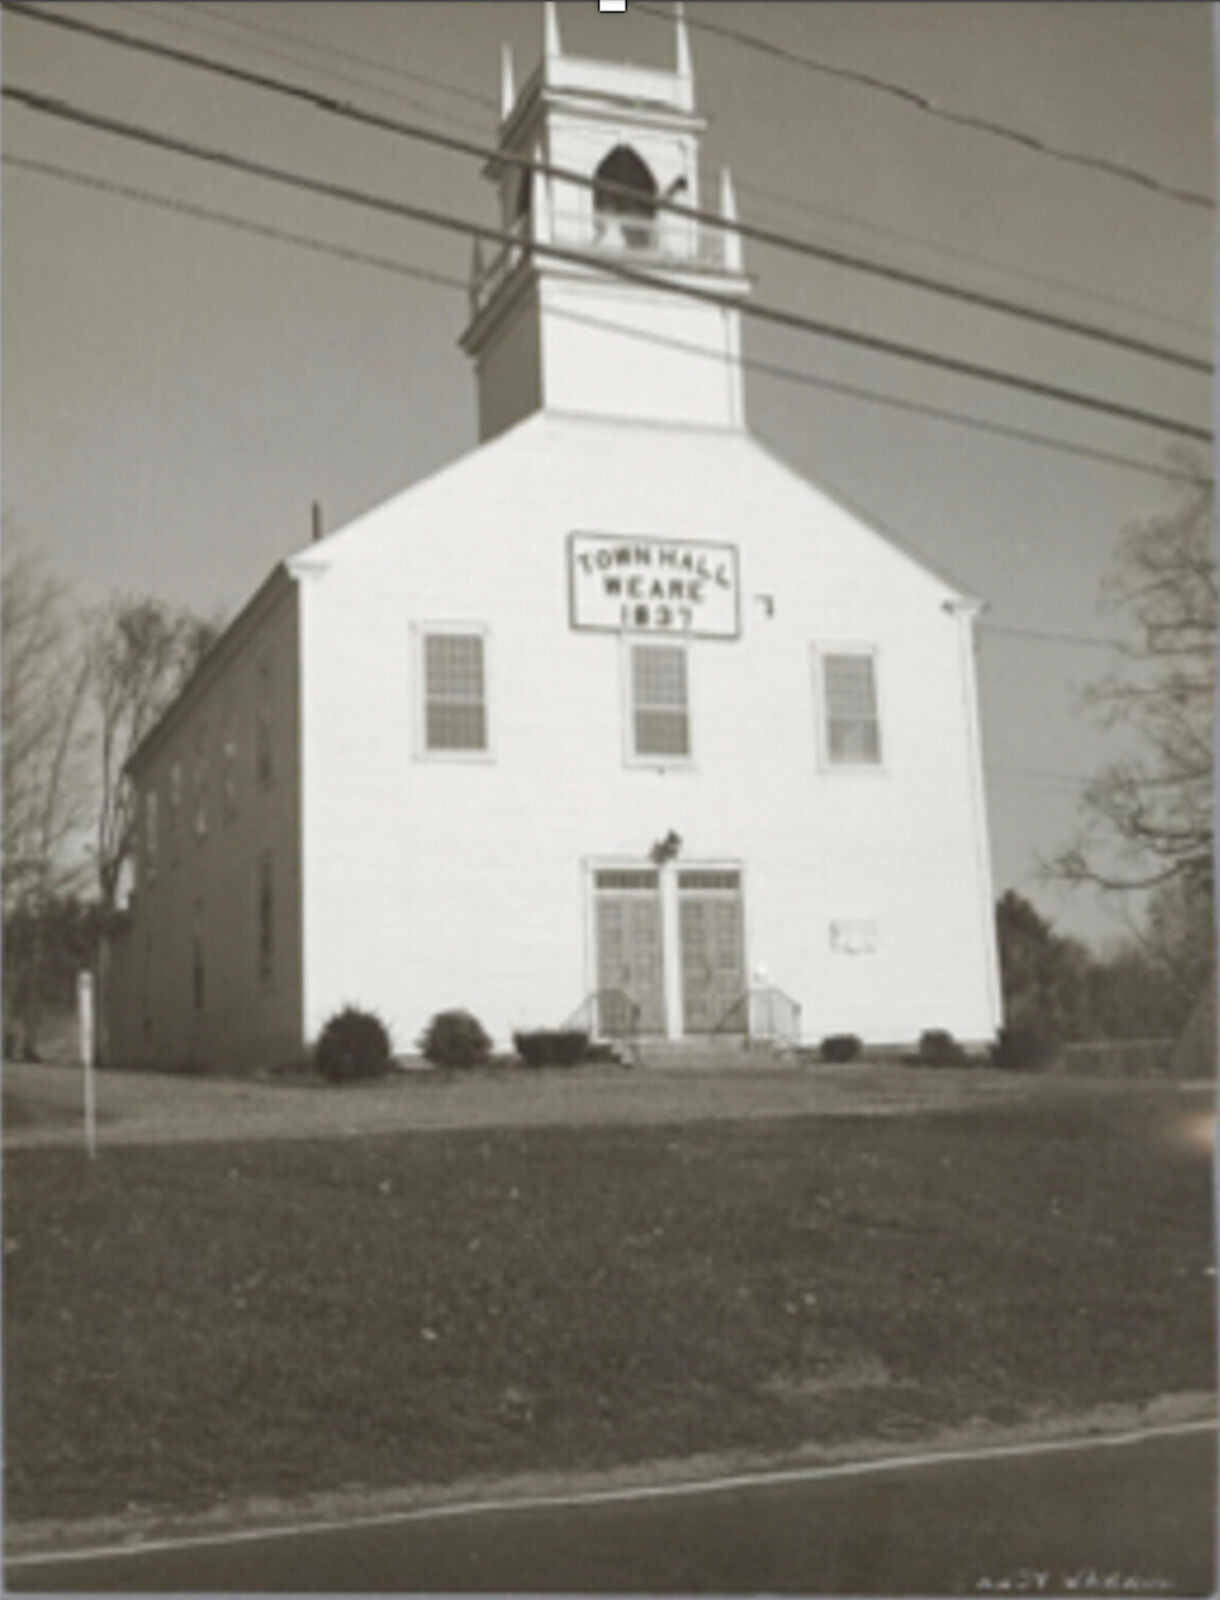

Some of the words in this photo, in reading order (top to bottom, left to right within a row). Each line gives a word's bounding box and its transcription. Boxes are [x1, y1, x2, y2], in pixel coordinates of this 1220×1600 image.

[577, 545, 650, 575] TOWN
[659, 547, 730, 588] HALL
[604, 577, 704, 604] WEARE
[621, 603, 693, 626] 1837
